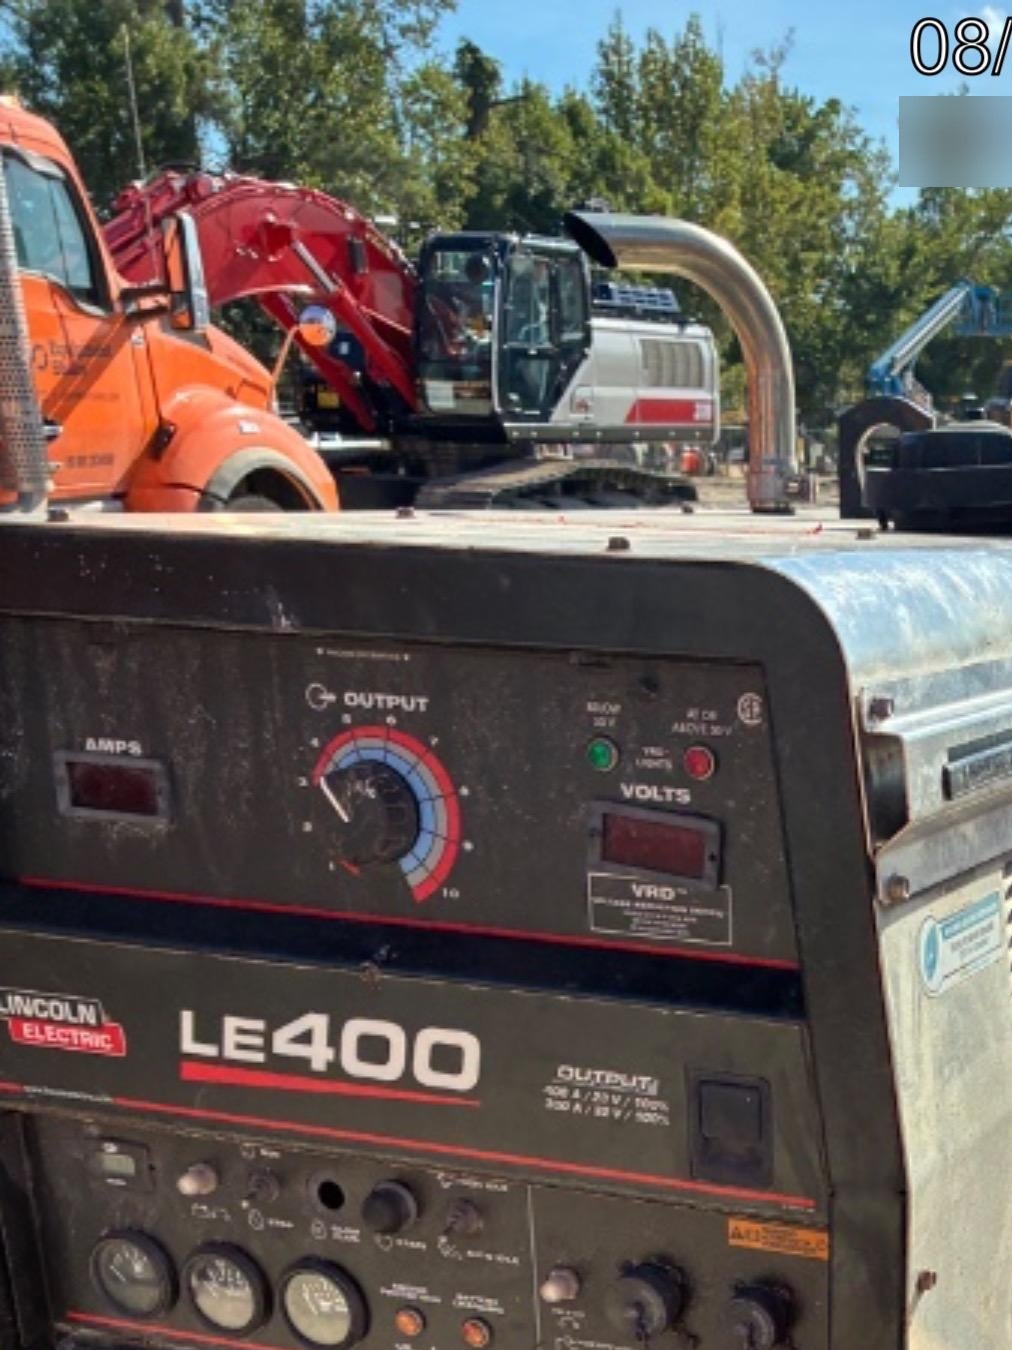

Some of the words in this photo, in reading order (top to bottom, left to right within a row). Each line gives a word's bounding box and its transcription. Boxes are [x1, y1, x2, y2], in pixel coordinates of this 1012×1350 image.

[343, 691, 430, 714] OUTPUT
[85, 737, 143, 756] AMPS
[619, 783, 691, 804] VOLTS
[22, 1021, 114, 1051] ELECTRIC
[179, 1009, 481, 1091] LE400
